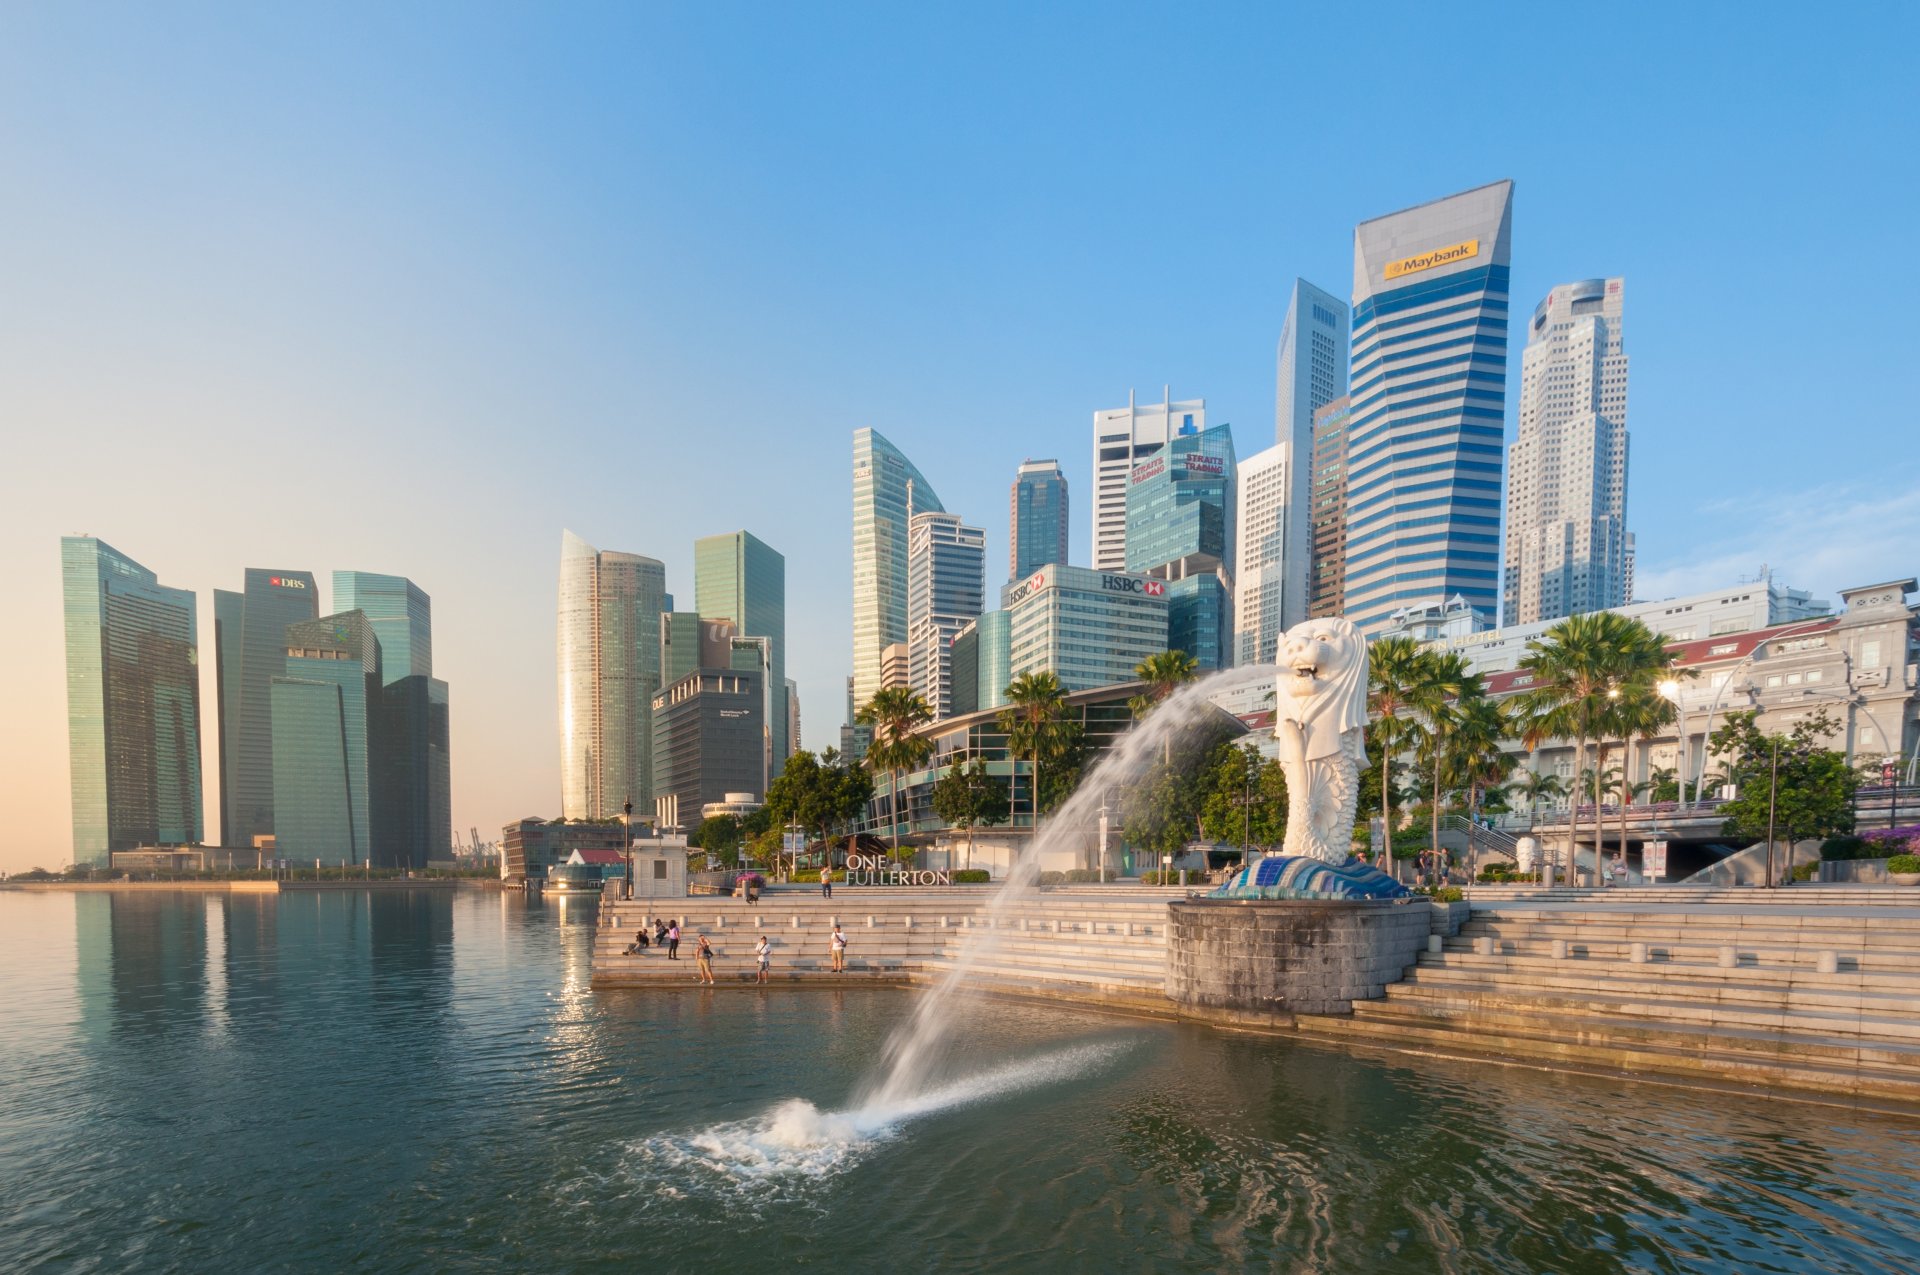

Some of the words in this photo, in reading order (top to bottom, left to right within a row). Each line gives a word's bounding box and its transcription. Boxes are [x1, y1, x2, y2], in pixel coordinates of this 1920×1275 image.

[1403, 245, 1469, 271] Maybank
[1131, 456, 1164, 478] STRAITS
[1186, 453, 1224, 465] STRAITS
[1131, 464, 1165, 486] TRADING
[1184, 462, 1223, 474] TRADING
[281, 578, 305, 589] DBS
[1102, 575, 1144, 593] HSBC
[1010, 580, 1032, 606] HSBC
[1454, 629, 1502, 647] HOTEL
[652, 696, 664, 711] OUE
[846, 854, 886, 870] ONE
[846, 870, 950, 886] FULLERTON
